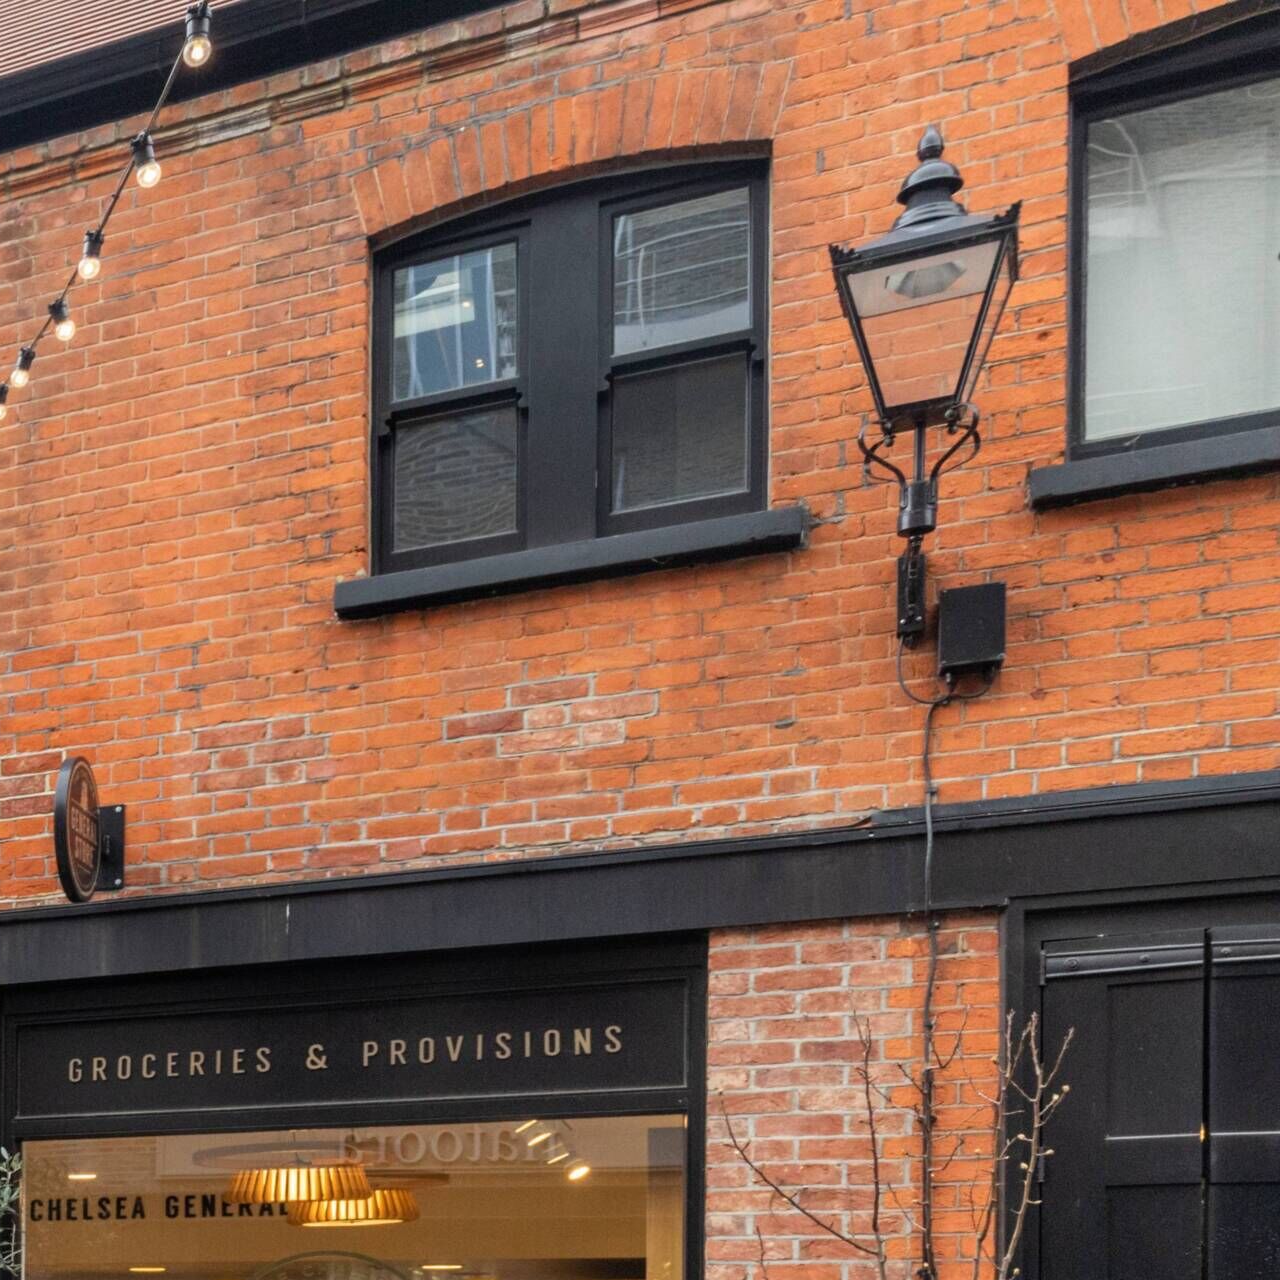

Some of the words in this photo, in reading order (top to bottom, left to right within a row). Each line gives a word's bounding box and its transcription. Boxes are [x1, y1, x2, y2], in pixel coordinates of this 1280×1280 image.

[68, 1046, 272, 1082] GROCERIES
[306, 1043, 329, 1070] &
[363, 1024, 623, 1067] PROVISIONS
[30, 1196, 146, 1222] CHELSEA
